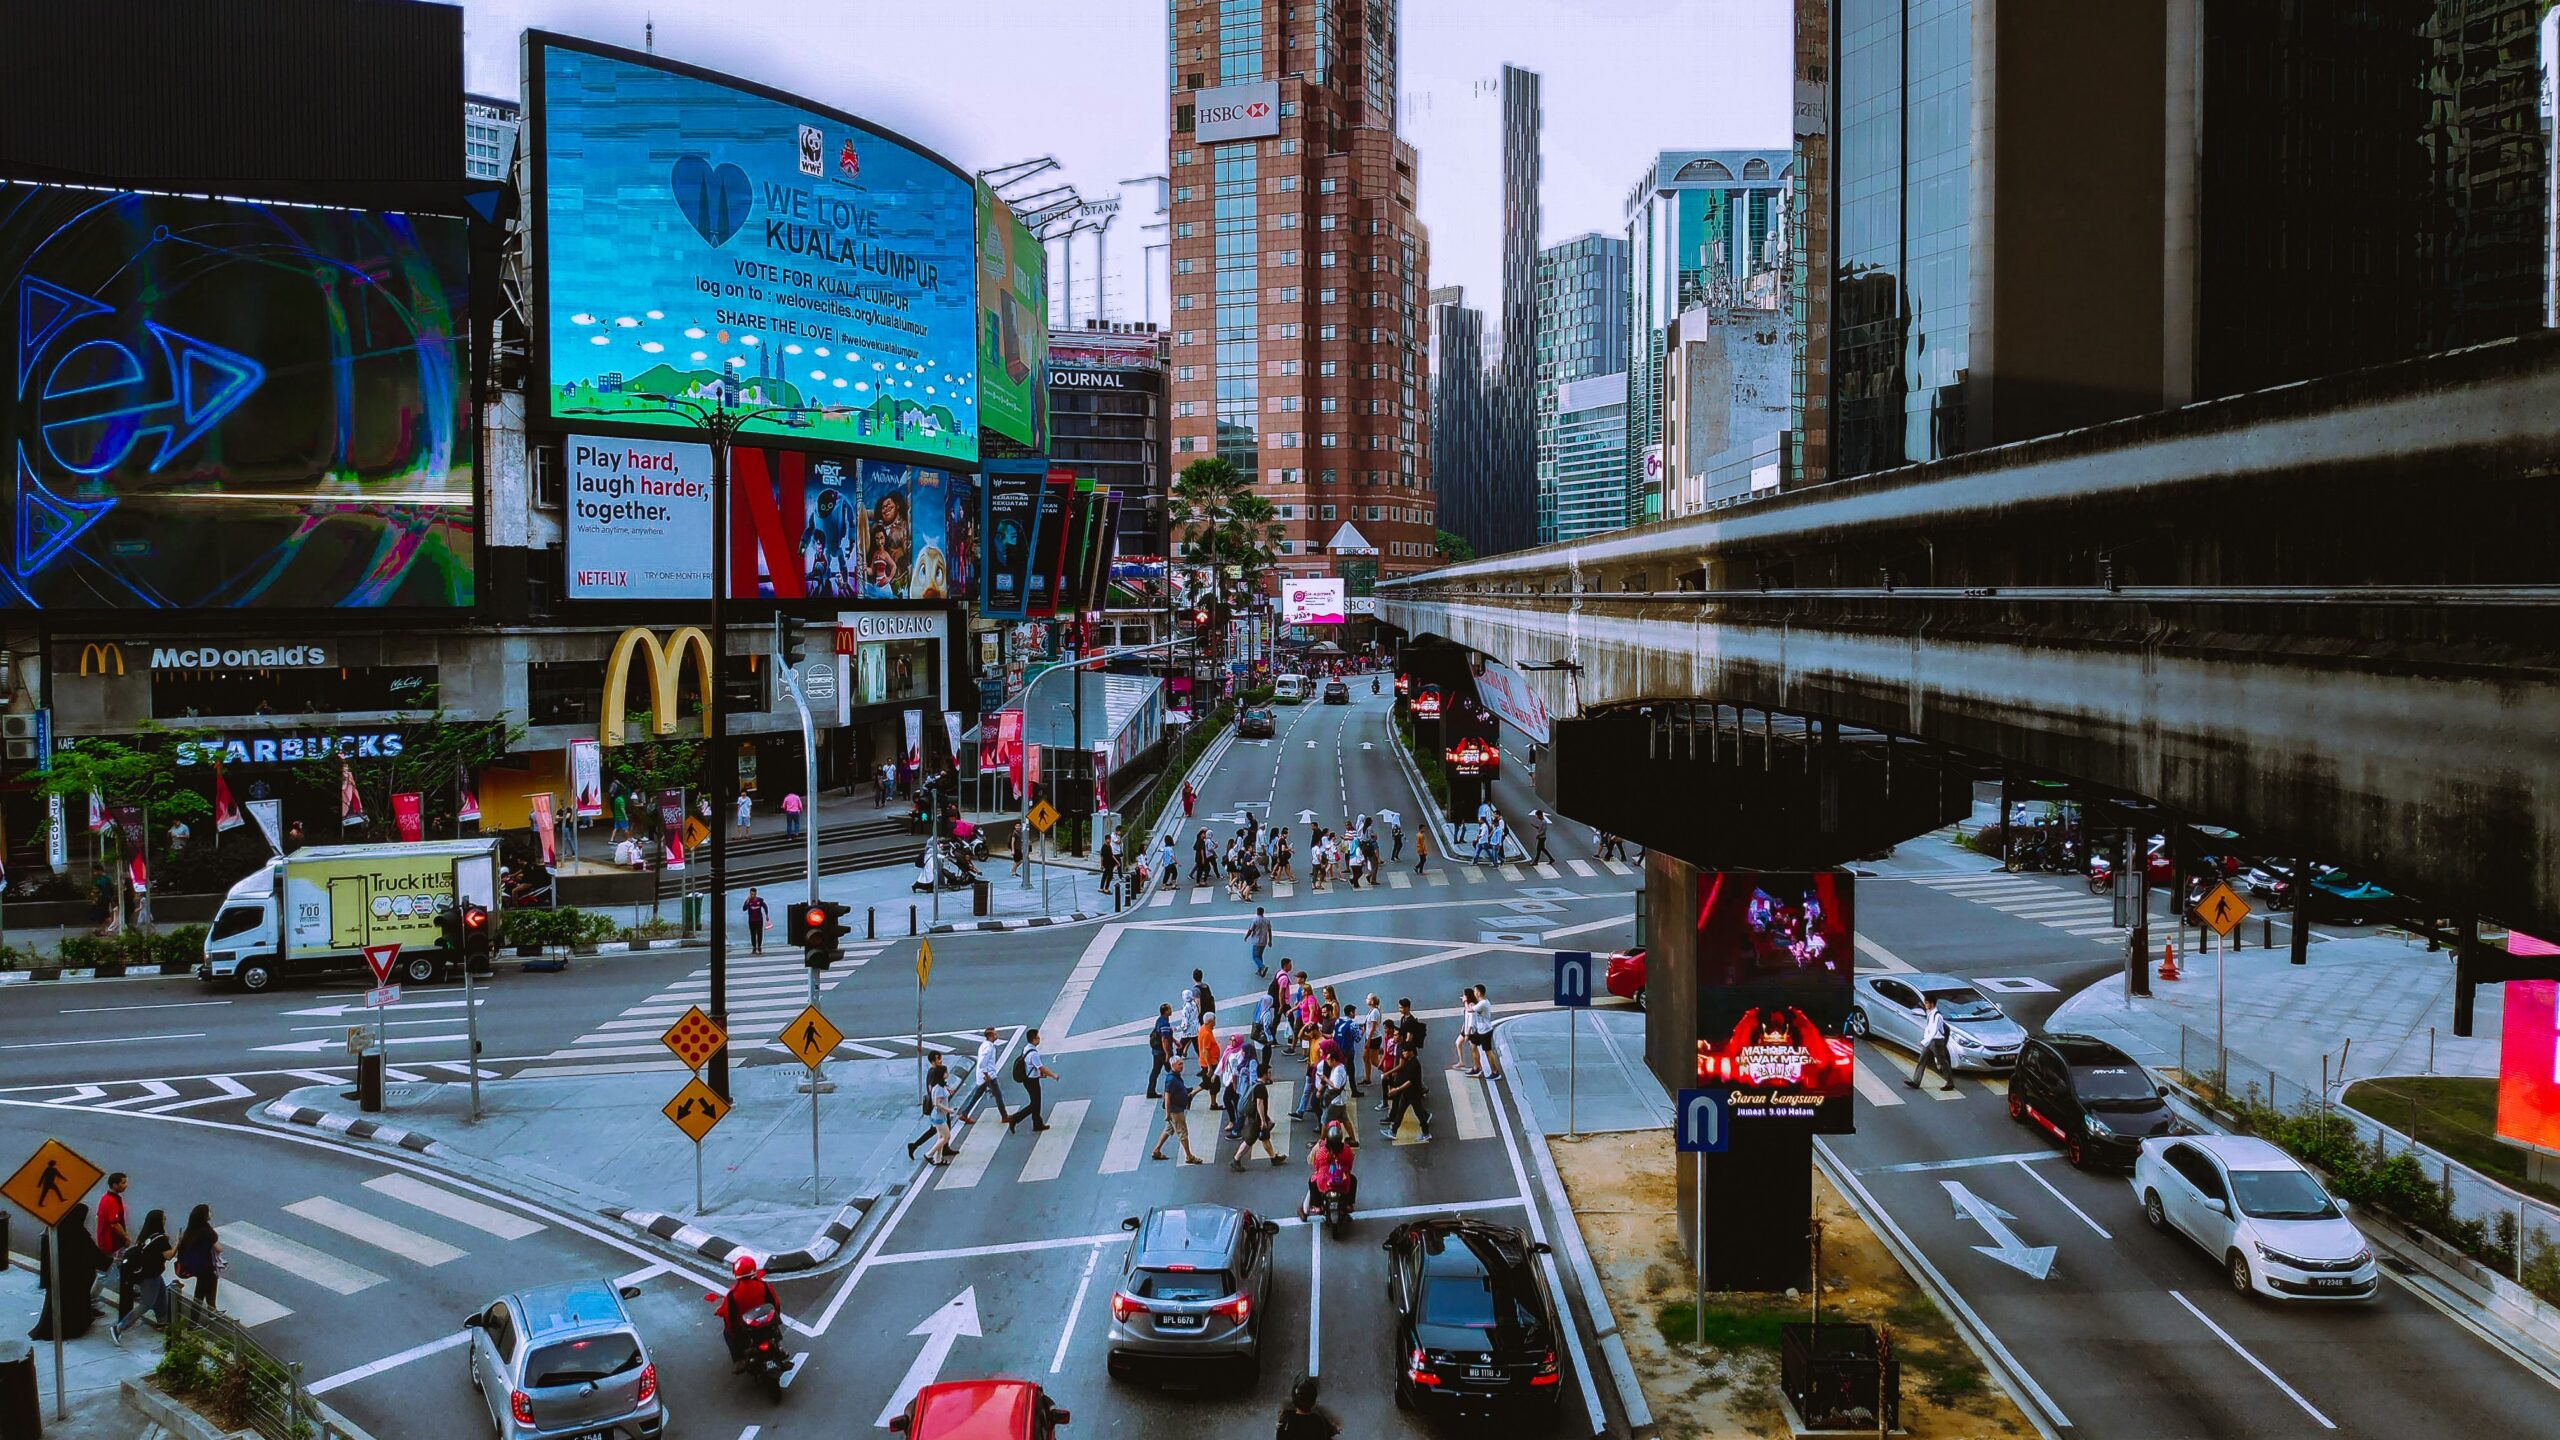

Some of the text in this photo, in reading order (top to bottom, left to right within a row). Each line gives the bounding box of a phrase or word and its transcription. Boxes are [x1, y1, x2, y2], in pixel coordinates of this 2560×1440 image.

[1200, 105, 1244, 124] HSBC
[801, 160, 822, 175] WWF
[764, 181, 880, 239] WE LOVE
[1040, 203, 1120, 223] HOTEL ISTANA
[765, 218, 939, 293] KUALA LUMPUR
[734, 258, 910, 313] VOTE FOR KUALA LUMPUR
[696, 276, 721, 297] log
[725, 282, 744, 298] on
[748, 285, 763, 301] to
[775, 291, 929, 338] welovecities.org/kualalumpur
[716, 309, 920, 360] SHARE THE LOVE #welovekualalumpur
[1049, 371, 1124, 388] JOURNAL
[576, 446, 679, 476] Play hard,
[814, 464, 842, 476] NEXT
[576, 471, 710, 502] laugh harder,
[822, 475, 847, 486] GEN
[871, 470, 901, 485] MOANA
[576, 498, 672, 524] together.
[577, 525, 600, 534] Watch
[601, 526, 630, 536] anytime,
[577, 571, 628, 587] NETFLIX
[644, 571, 659, 580] TRY
[660, 572, 675, 580] ONE
[676, 572, 702, 580] MONTH
[1344, 600, 1365, 611] SBC
[858, 616, 934, 637] GIORDANO
[150, 645, 326, 669] McDonald's
[57, 738, 76, 750] KAFE
[175, 733, 404, 767] STARBUCKS
[300, 906, 320, 916] 700
[1741, 1046, 1811, 1056] MAHARAJA
[1727, 1090, 1825, 1107] Siaran Langsung
[1768, 1107, 1787, 1116] 9.00
[1788, 1107, 1815, 1116] Malam
